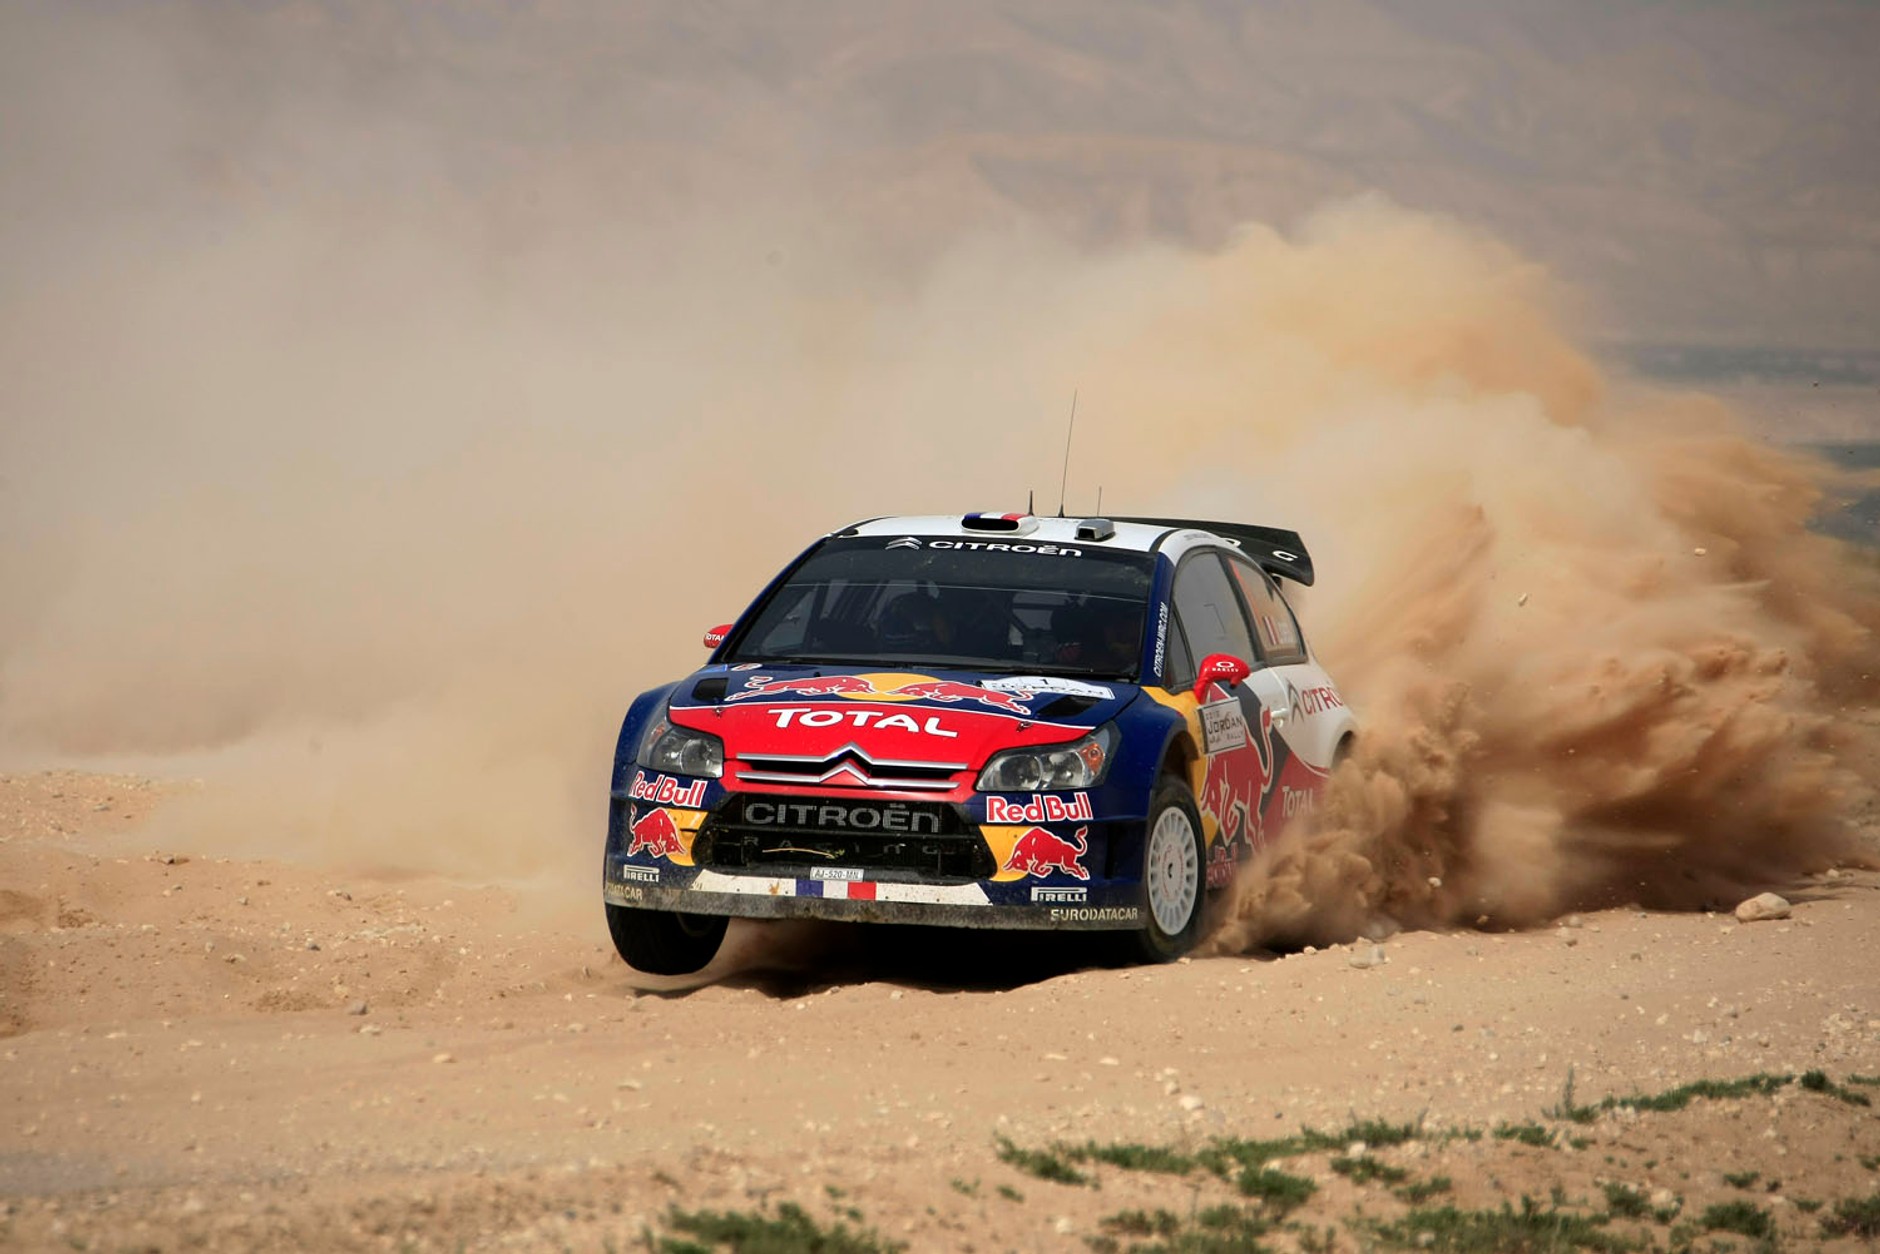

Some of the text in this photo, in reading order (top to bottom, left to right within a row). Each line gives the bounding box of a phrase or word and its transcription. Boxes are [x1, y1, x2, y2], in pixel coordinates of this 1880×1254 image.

[768, 708, 958, 737] TOTAL
[1208, 714, 1244, 734] JORDAN
[628, 771, 707, 808] Red Bull
[986, 791, 1094, 823] Red Bull
[623, 864, 660, 882] PIRELLI
[1031, 886, 1088, 902] PIRELLI
[1050, 907, 1138, 921] EURODATACAR
